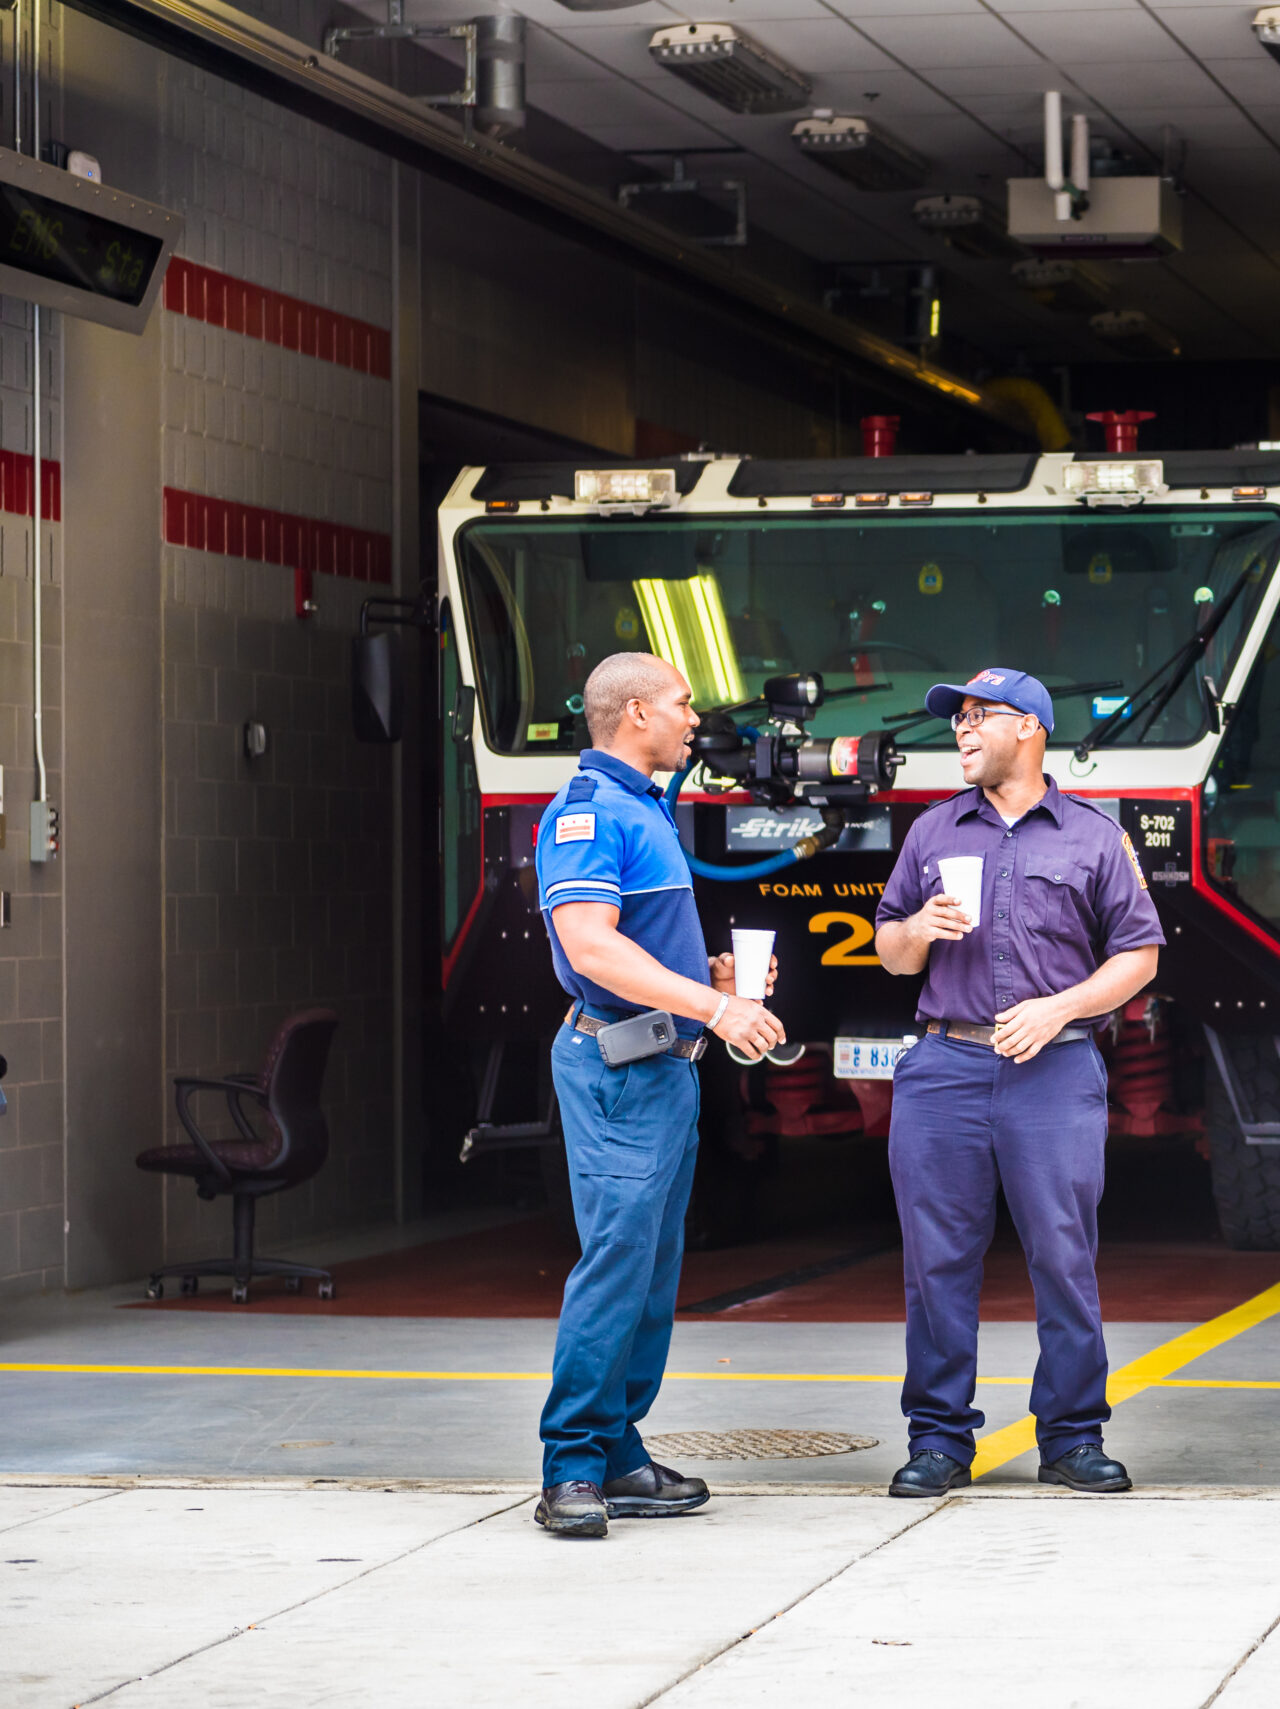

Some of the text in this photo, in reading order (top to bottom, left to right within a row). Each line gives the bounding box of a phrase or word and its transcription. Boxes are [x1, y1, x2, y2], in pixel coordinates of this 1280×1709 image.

[10, 209, 63, 259] EMS
[101, 240, 144, 288] Sta
[1140, 814, 1175, 830] S-702
[1145, 832, 1171, 847] 2011
[759, 882, 886, 897] FOAM UNIT
[808, 911, 882, 966] 2
